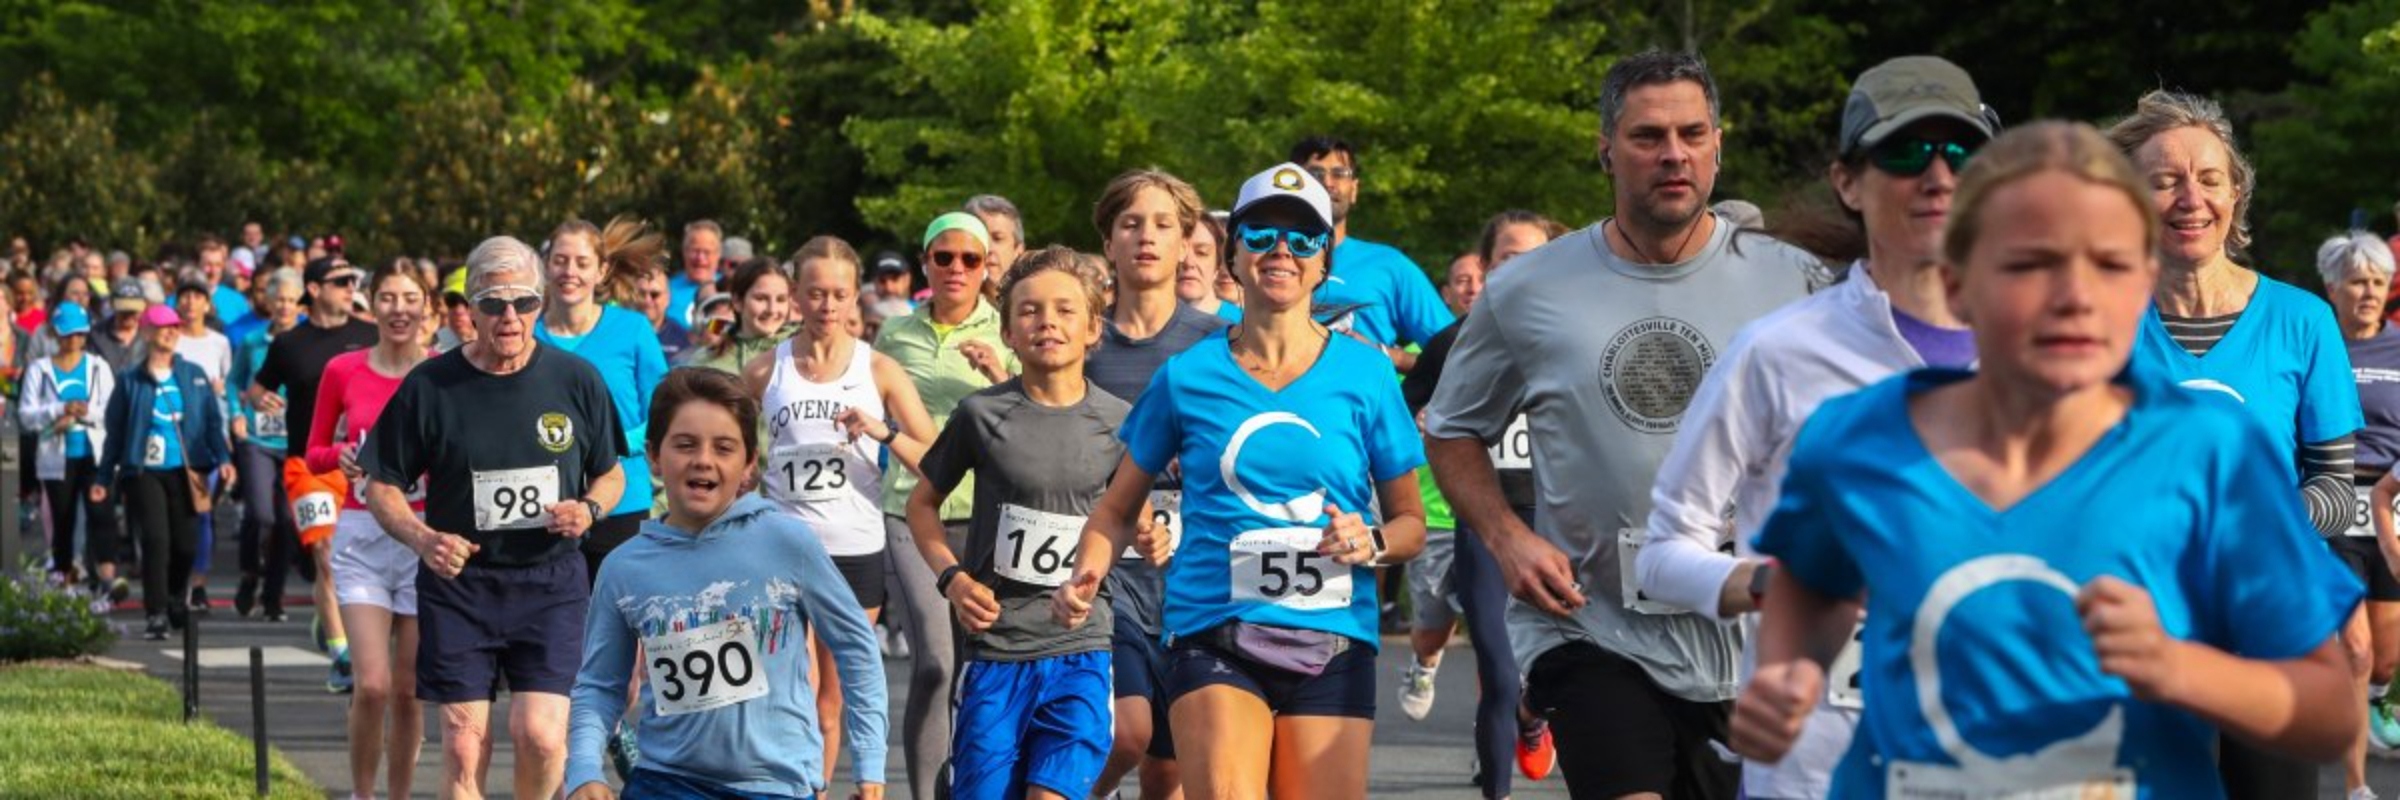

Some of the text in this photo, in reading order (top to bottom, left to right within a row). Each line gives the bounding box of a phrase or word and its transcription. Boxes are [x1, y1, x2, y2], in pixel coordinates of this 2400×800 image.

[1602, 320, 1678, 379] CHARLOTTESVILLE
[1679, 324, 1699, 344] TEN
[769, 398, 849, 440] COVENA
[781, 457, 847, 493] 123
[493, 485, 540, 521] 98
[1259, 551, 1323, 598] 55
[653, 641, 753, 701] 390
